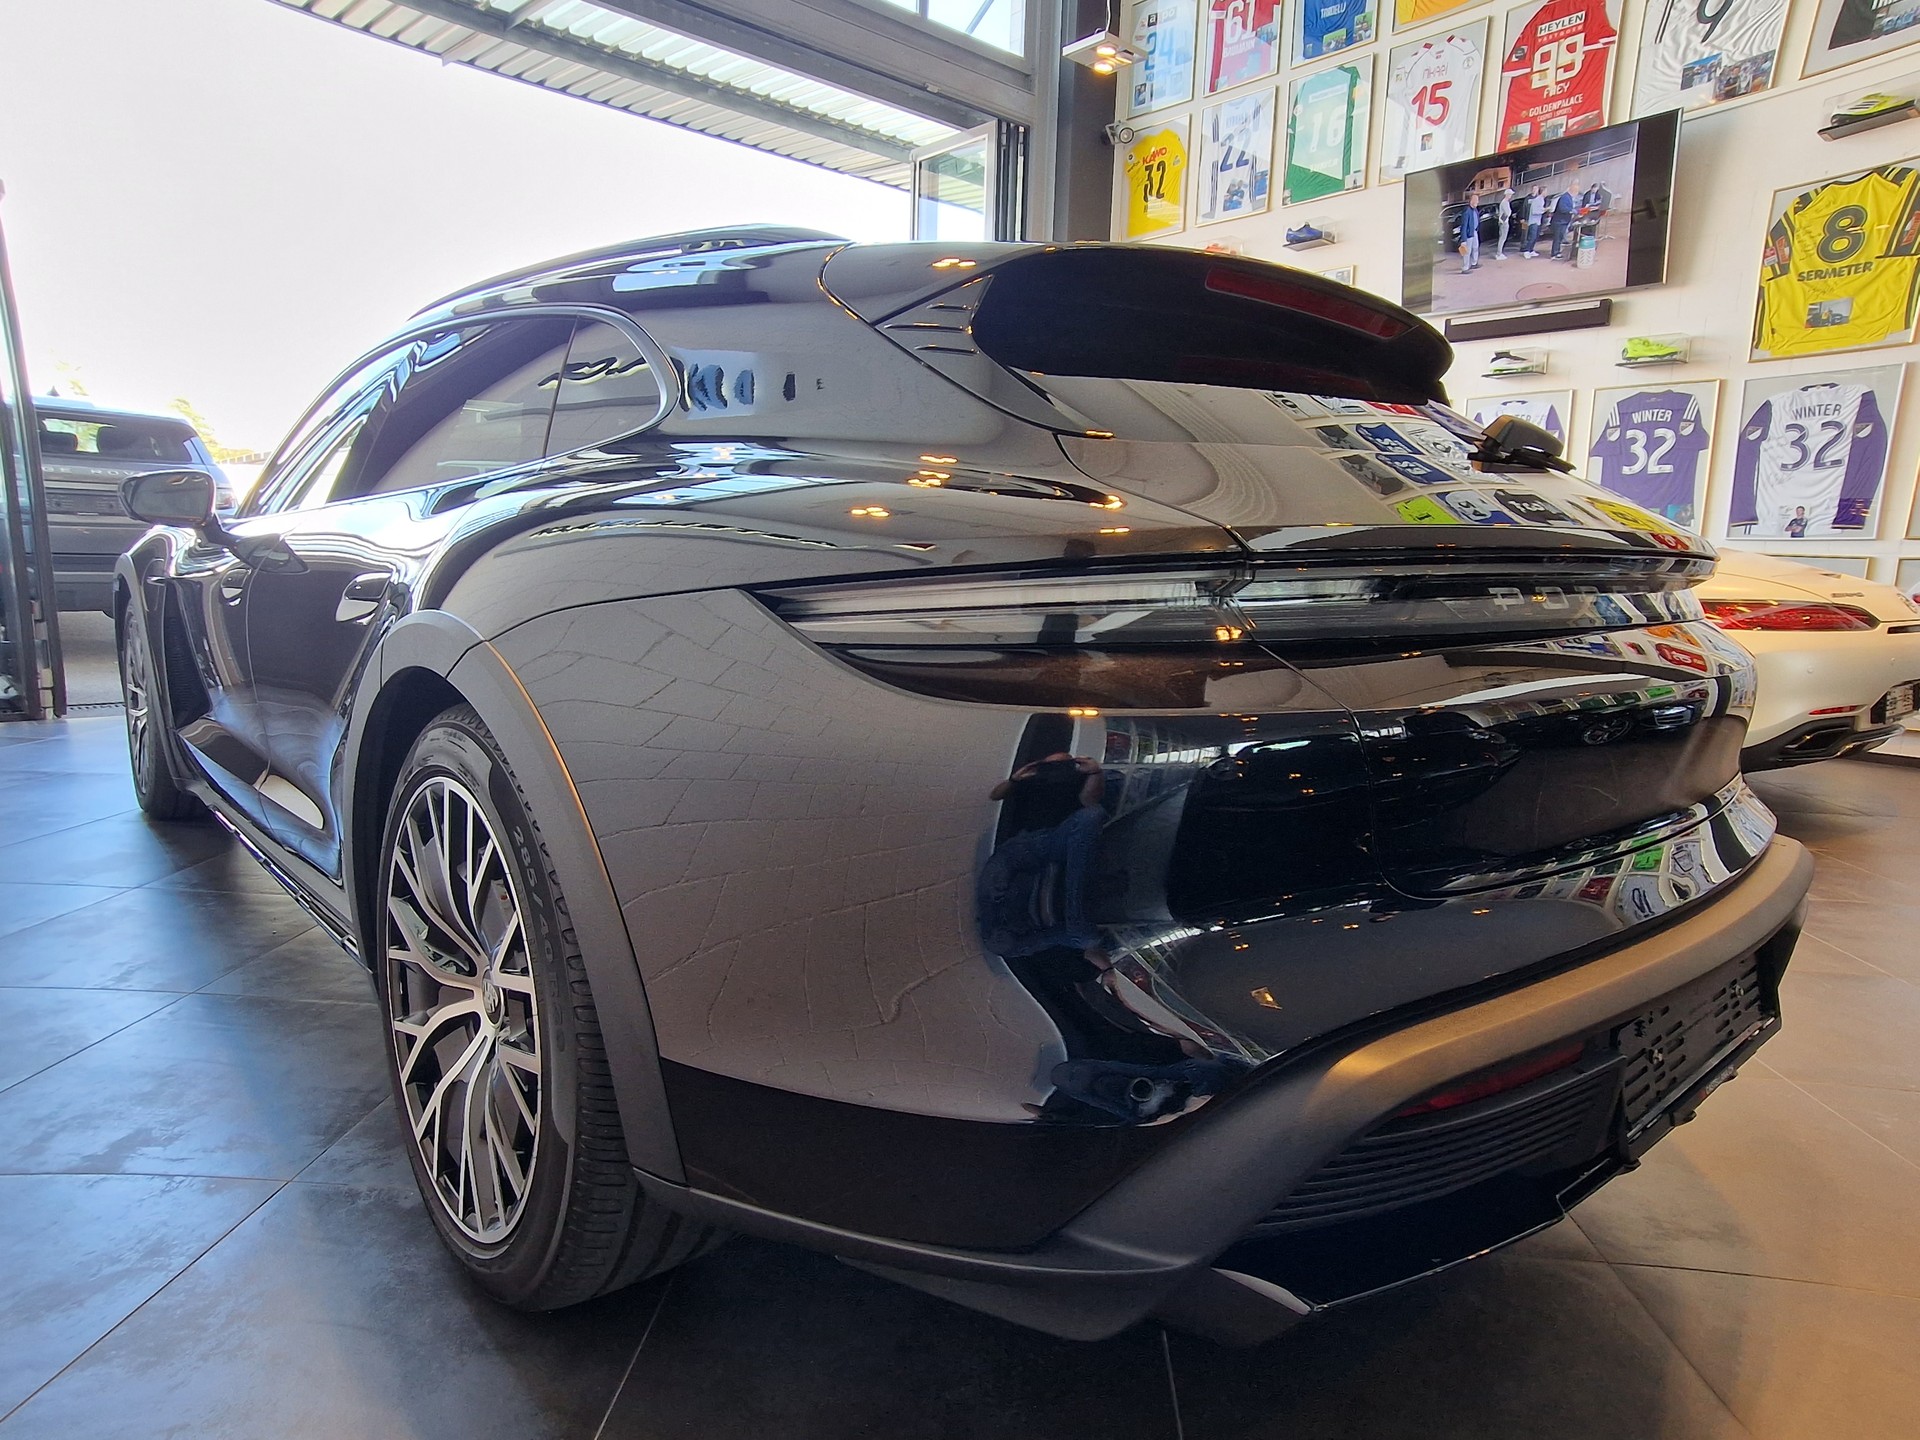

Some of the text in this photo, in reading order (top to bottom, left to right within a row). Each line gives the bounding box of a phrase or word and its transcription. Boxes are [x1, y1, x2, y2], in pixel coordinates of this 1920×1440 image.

[1225, 0, 1257, 44] 61
[1538, 13, 1584, 35] HEYLEN
[1531, 33, 1586, 89] 99
[1411, 80, 1452, 130] 15
[1528, 93, 1585, 118] GOLDENPALACE
[1143, 160, 1167, 203] 32
[1817, 204, 1868, 264] 8
[1797, 261, 1875, 282] SERMETER
[1632, 408, 1673, 424] WINTER
[1791, 403, 1842, 421] WINTER
[1621, 427, 1677, 475] 32
[1780, 420, 1847, 472] 32
